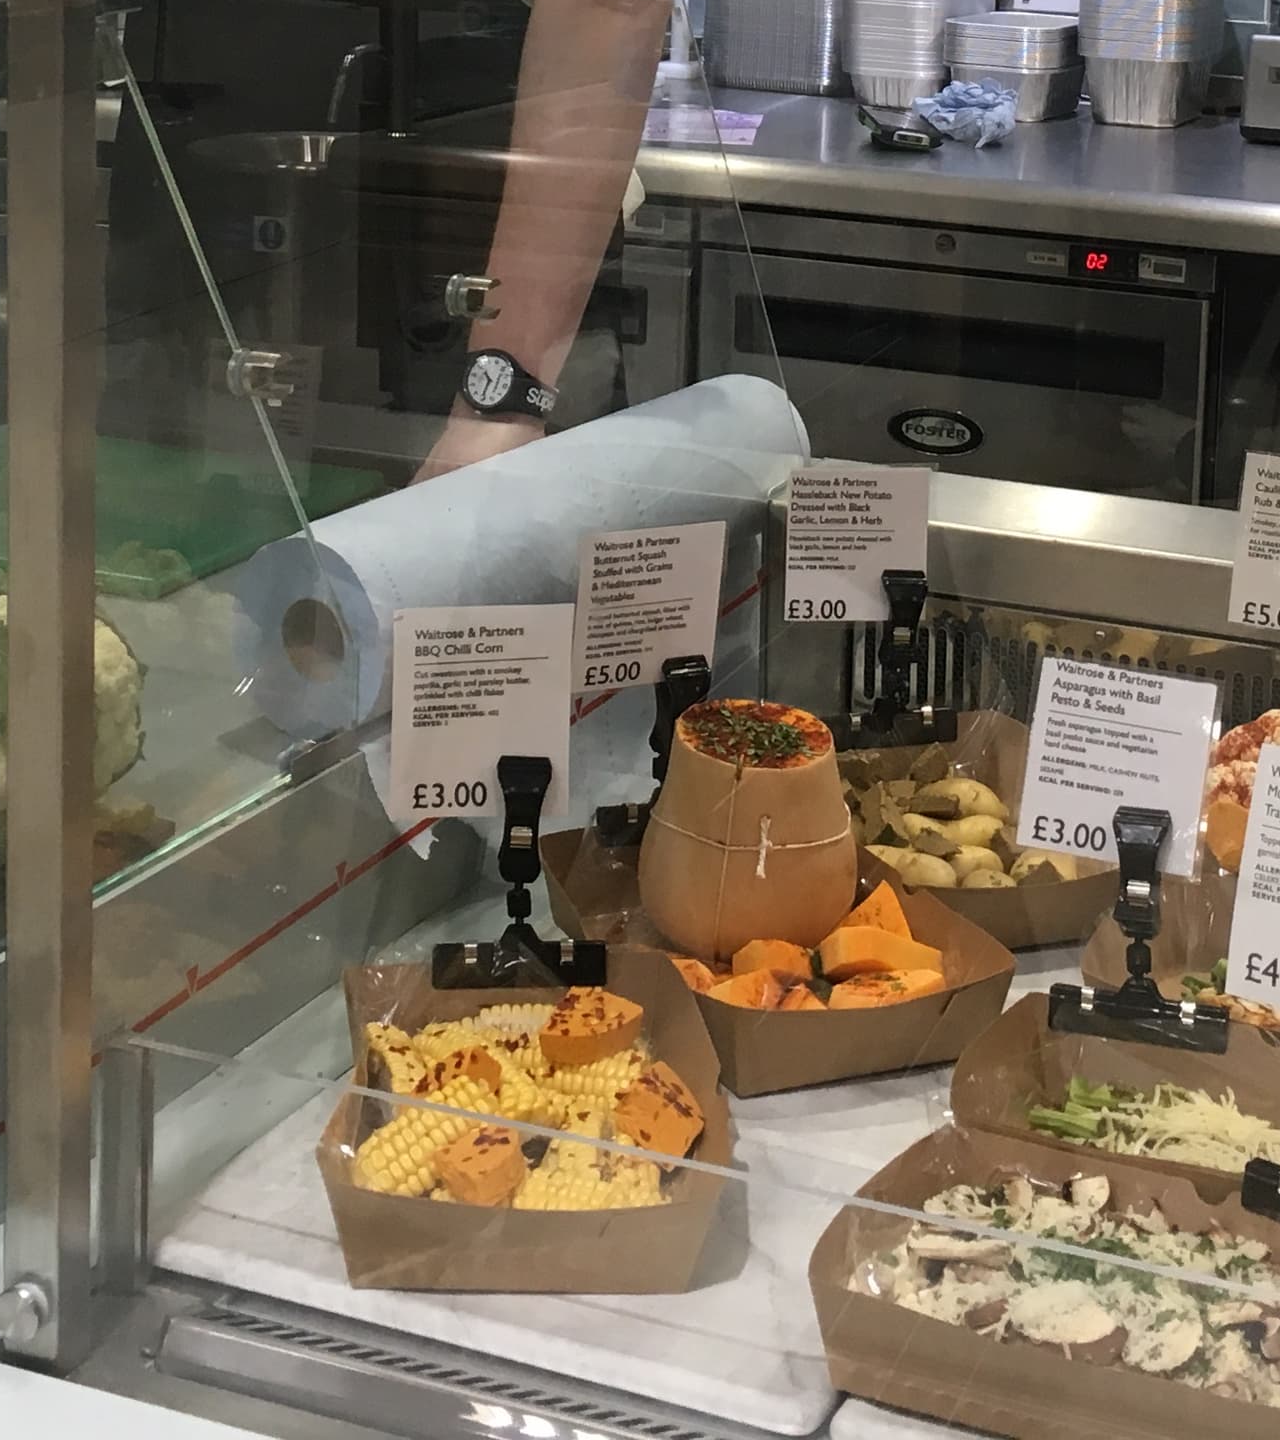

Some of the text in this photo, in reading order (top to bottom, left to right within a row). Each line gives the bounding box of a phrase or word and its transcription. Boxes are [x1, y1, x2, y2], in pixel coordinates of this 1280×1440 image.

[1086, 251, 1109, 271] 02
[904, 422, 967, 441] FOSTER
[792, 477, 878, 487] Waitrose & Partners
[840, 490, 861, 500] New
[863, 490, 893, 500] Potato
[1254, 495, 1273, 508] Rub
[791, 502, 871, 512] Dressed with Black
[819, 515, 849, 525] Lemon
[860, 515, 883, 525] Herb
[594, 541, 634, 551] Waitrose
[645, 537, 681, 547] Partners
[593, 549, 667, 566] Butternut Squash
[624, 564, 644, 574] with
[788, 598, 847, 619] £3.00
[415, 626, 525, 640] Waitrose & Partners
[414, 642, 504, 658] BBQ Chilli Corn
[583, 660, 641, 687] £5.00
[1056, 660, 1164, 690] Waitrose & Partners
[1052, 677, 1161, 705] Asparagus with Basil
[1050, 691, 1125, 716] Pesto & Seeds
[411, 780, 489, 810] £3.00
[1031, 815, 1108, 852] £3.00
